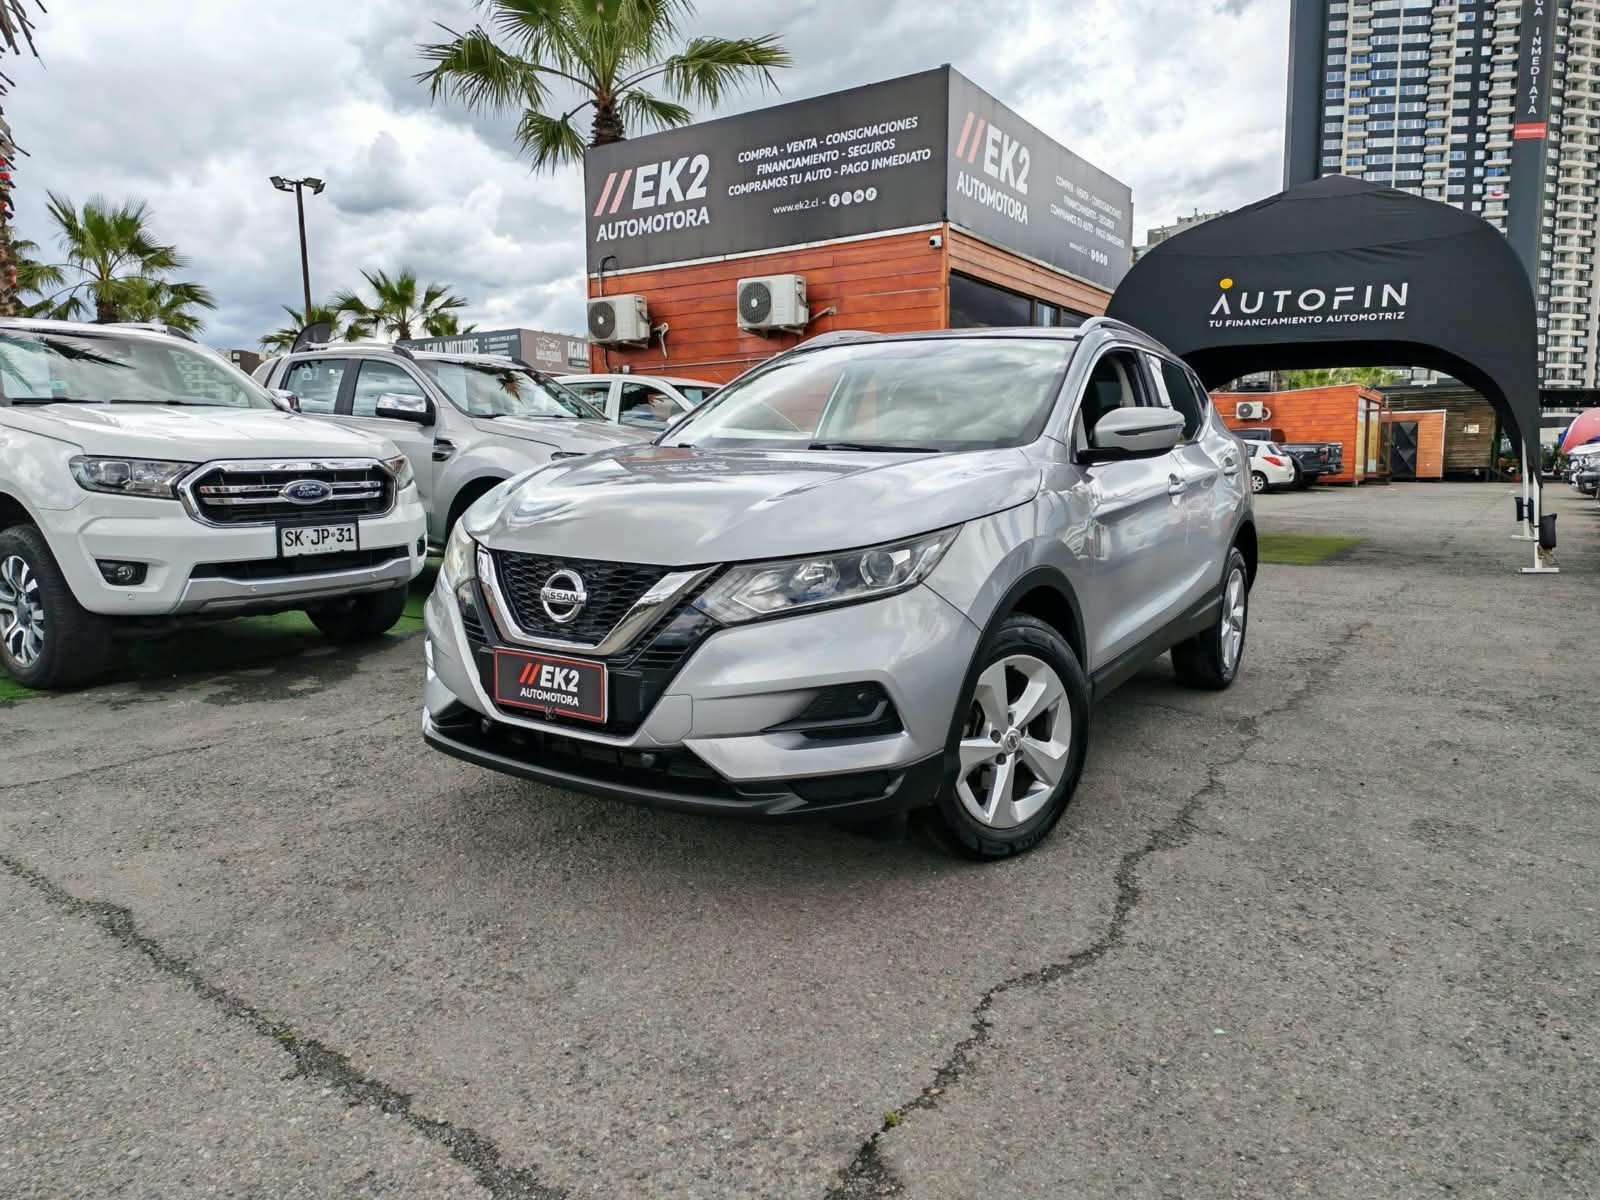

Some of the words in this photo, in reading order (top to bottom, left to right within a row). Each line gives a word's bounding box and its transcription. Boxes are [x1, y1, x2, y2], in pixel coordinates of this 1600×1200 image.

[1528, 27, 1542, 114] INMEDIATA
[738, 145, 778, 163] COMPRA
[786, 138, 818, 154] VENTA
[825, 116, 919, 145] CONSIGNACIONES
[757, 149, 839, 176] FINANCIAMIENTO
[847, 138, 896, 158] SEGUROS
[728, 174, 788, 196] COMPRAMOS
[790, 172, 802, 185] TU
[804, 167, 832, 183] AUTO
[840, 161, 869, 176] PAGO
[871, 148, 931, 170] INMEDIATO
[773, 198, 819, 214] www.ek2.cl
[956, 170, 1028, 225] AUTOMOTORA
[596, 206, 710, 242] AUTOMOTORA
[1210, 280, 1409, 315] AUTOFIN
[1208, 319, 1223, 328] TU
[1225, 315, 1323, 328] FINANCIAMIENTO
[1326, 311, 1405, 323] AUTOMOTRIZ
[542, 590, 579, 602] NISSAN
[520, 687, 579, 707] AUTOMOTORA
